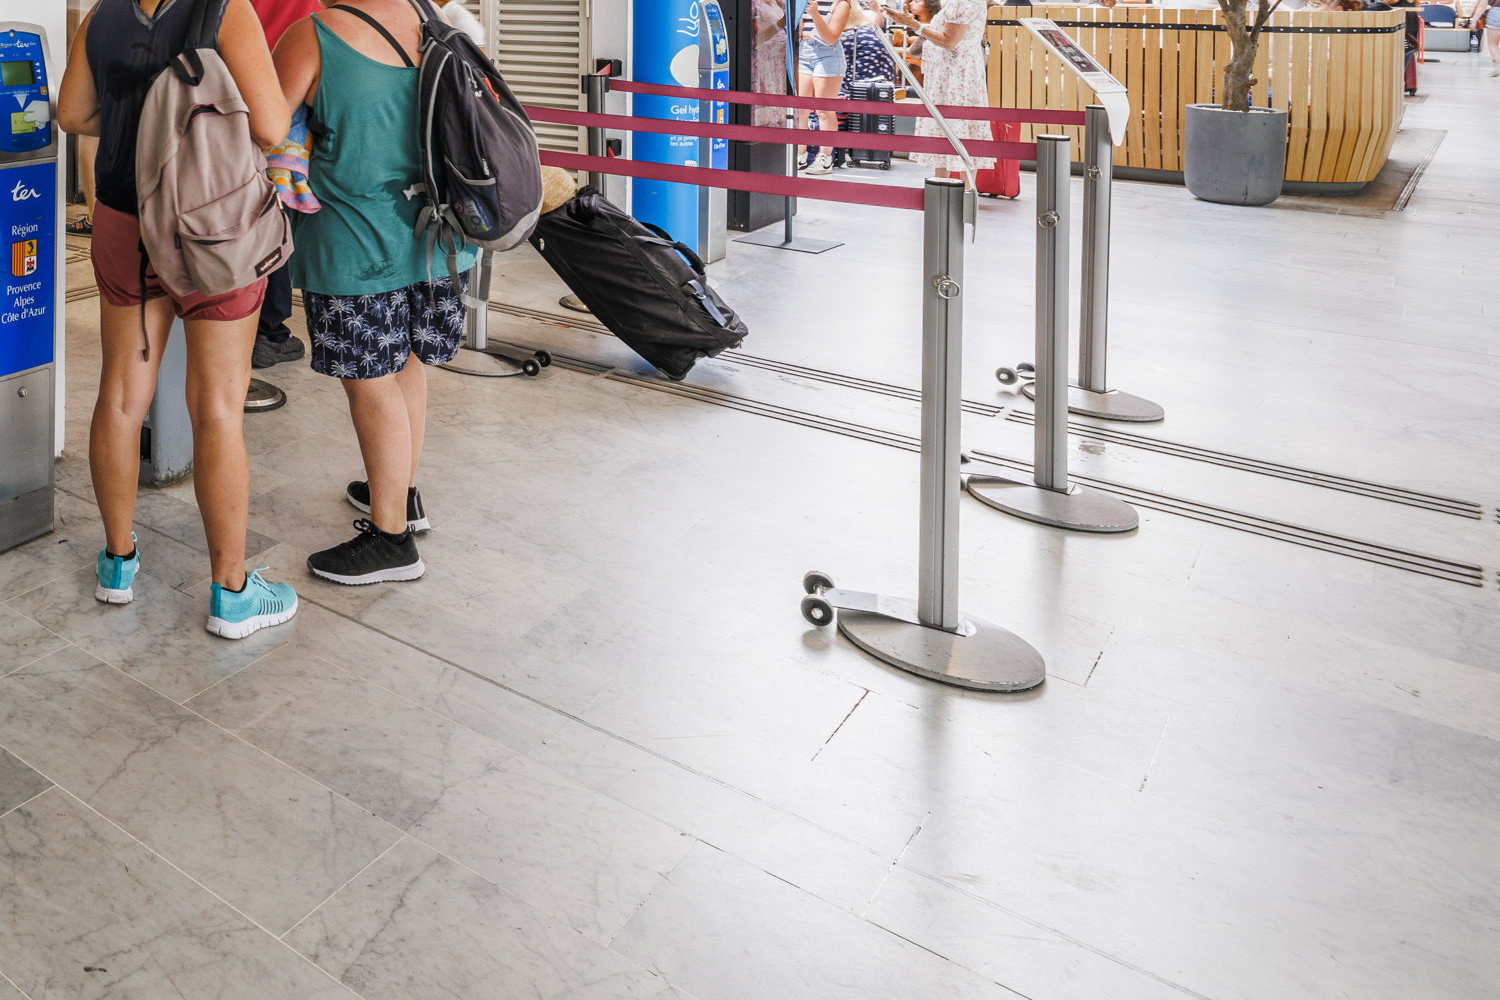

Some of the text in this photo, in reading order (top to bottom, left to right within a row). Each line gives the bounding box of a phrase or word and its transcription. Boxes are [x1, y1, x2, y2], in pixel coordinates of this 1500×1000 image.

[670, 105, 687, 114] Gel
[11, 180, 41, 201] ter
[12, 223, 38, 237] Région
[7, 281, 42, 295] Provence
[14, 296, 34, 309] Alpes
[1, 306, 46, 324] Côte d'Azur
